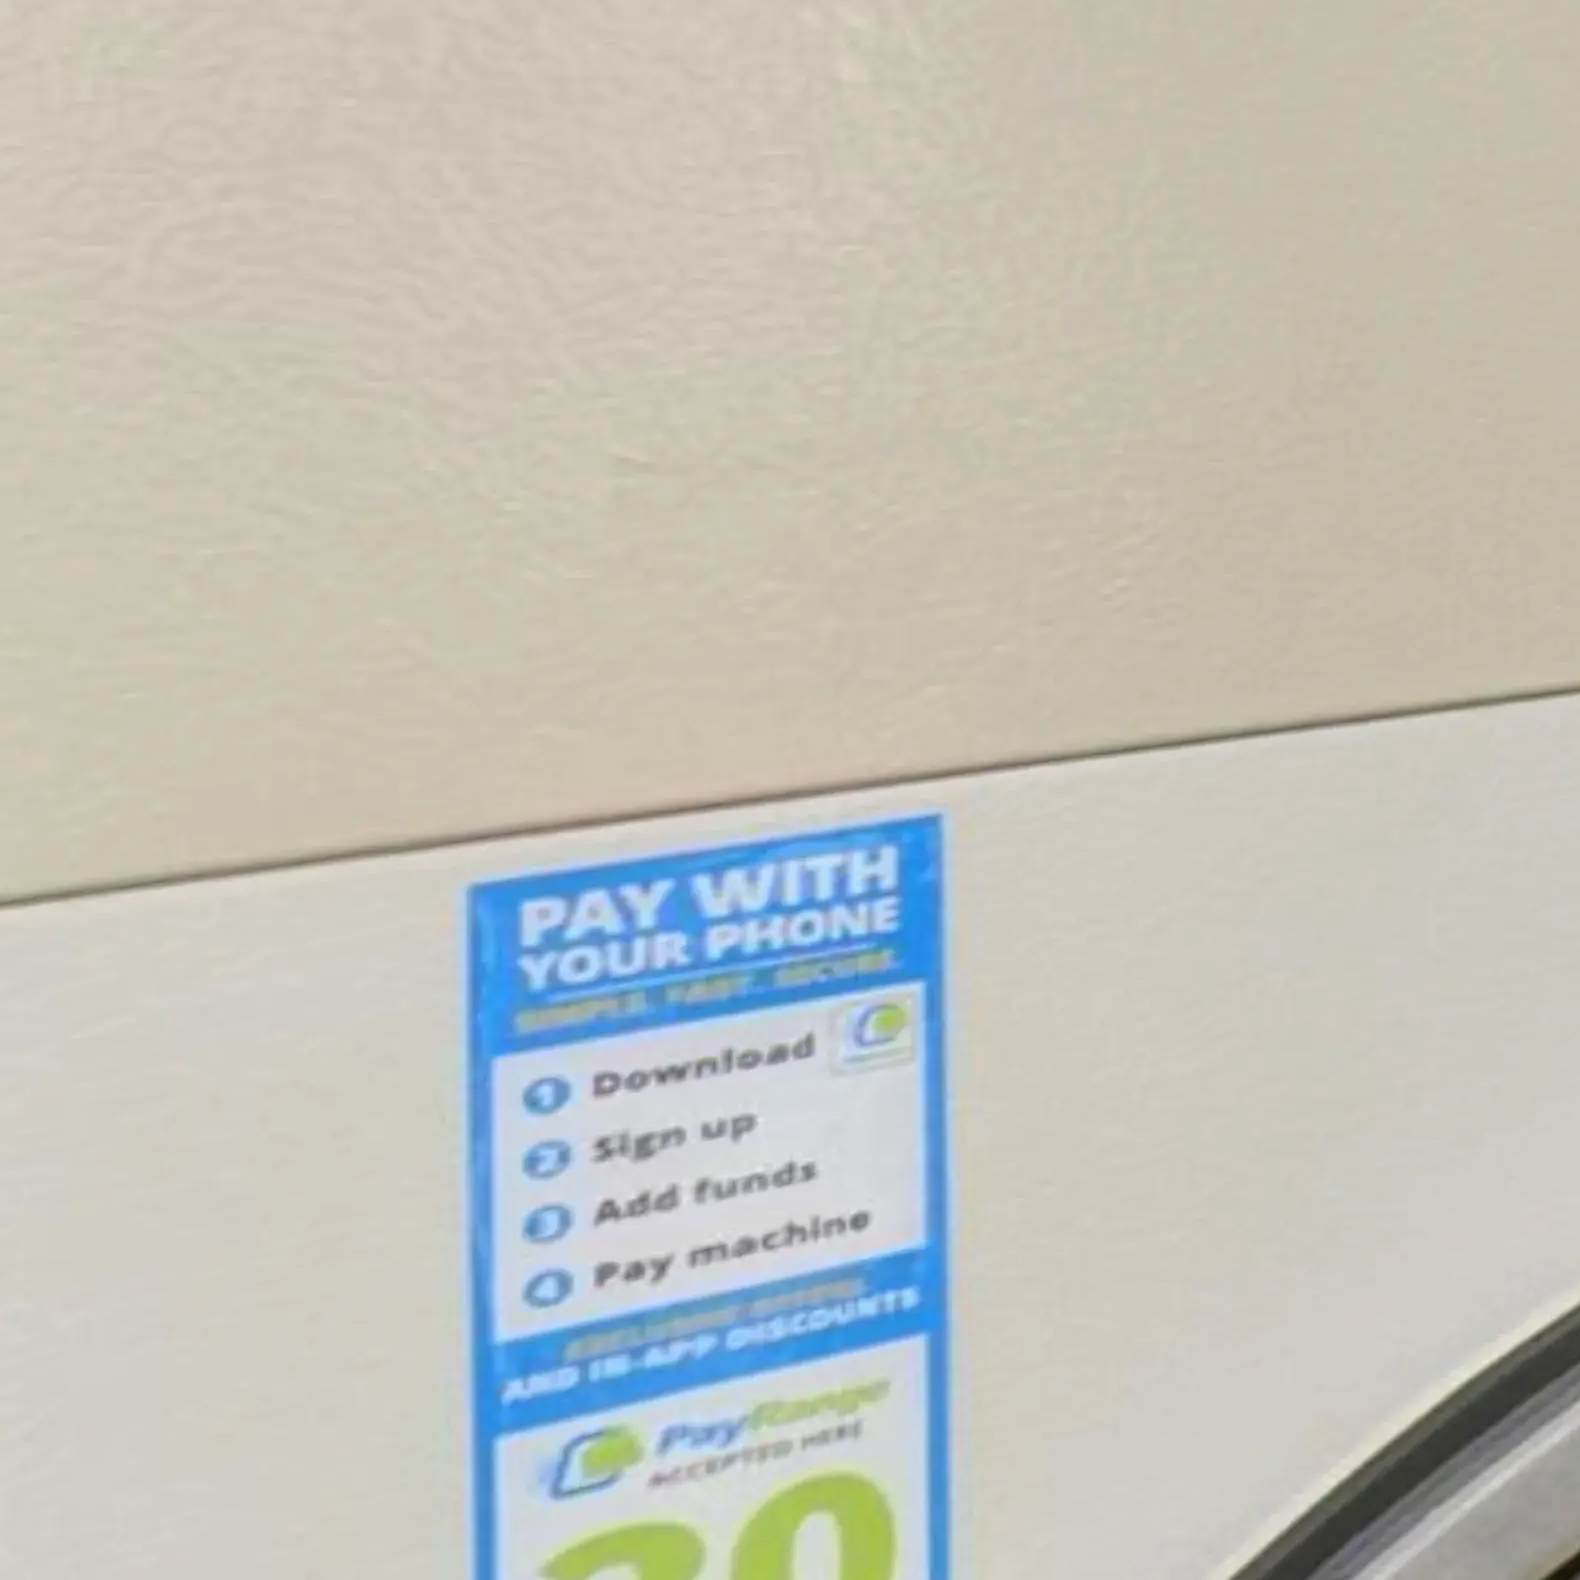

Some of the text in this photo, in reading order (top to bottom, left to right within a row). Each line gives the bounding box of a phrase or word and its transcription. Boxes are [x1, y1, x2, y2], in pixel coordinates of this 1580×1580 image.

[518, 846, 900, 948] PAY WITH
[516, 896, 900, 993] YOUR PHONE
[593, 1032, 817, 1099] Download
[590, 1125, 687, 1165] Sign
[700, 1111, 759, 1144] up
[593, 1184, 682, 1228] Add
[692, 1160, 819, 1204] funds
[593, 1251, 675, 1288] Pay
[686, 1209, 874, 1269] machine
[501, 1365, 580, 1407] AND
[725, 1287, 921, 1351] DISCOUNTS
[646, 1419, 864, 1489] ACCEPTED HERE
[656, 1377, 891, 1457] PayRange
